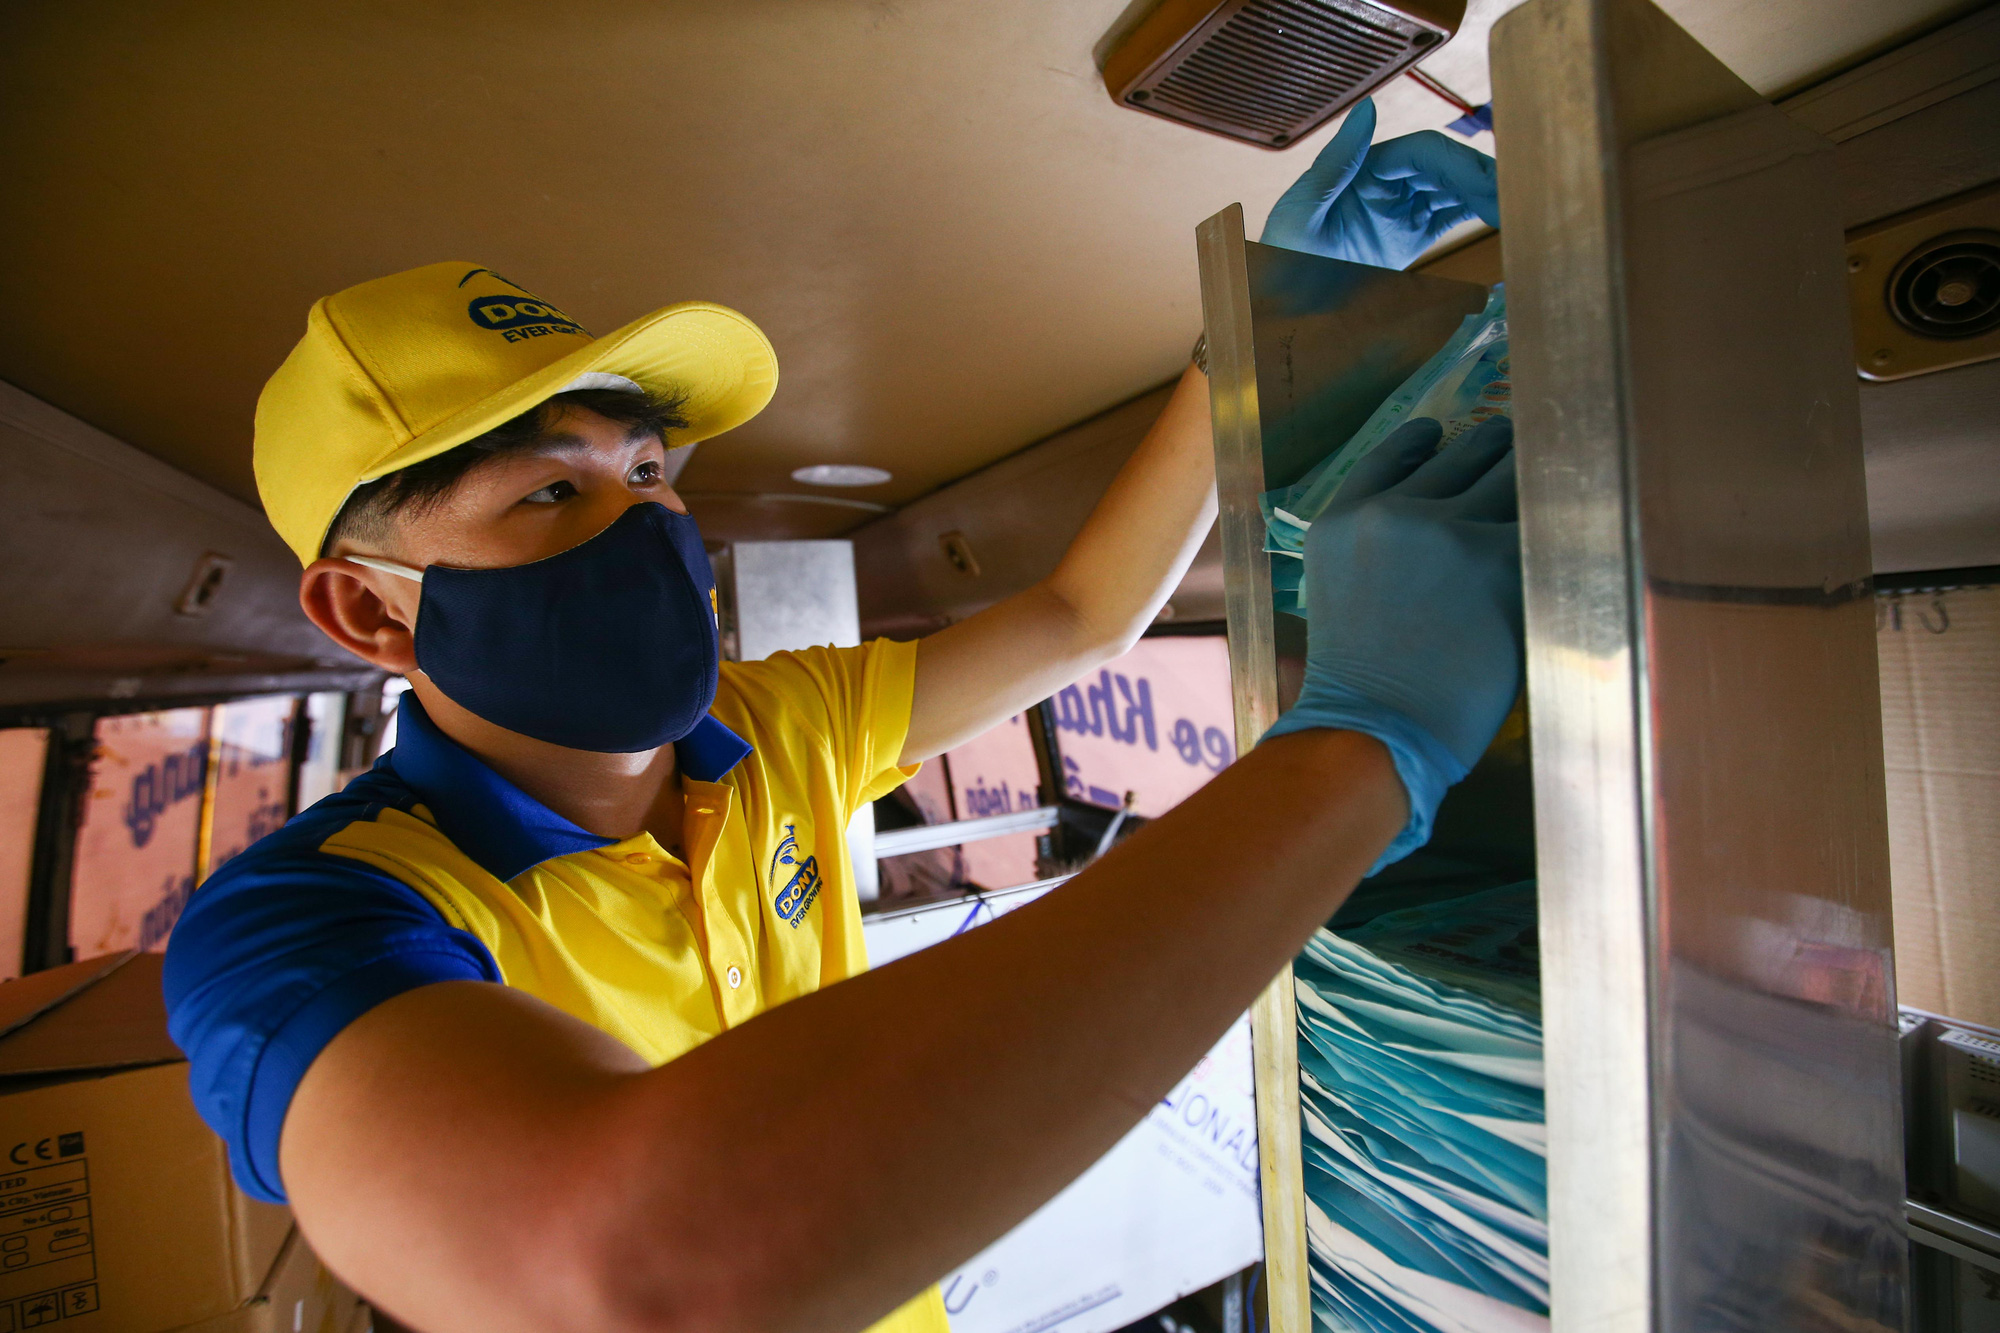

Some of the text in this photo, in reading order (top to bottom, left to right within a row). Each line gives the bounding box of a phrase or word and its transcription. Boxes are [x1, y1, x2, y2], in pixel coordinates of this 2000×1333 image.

[501, 325, 552, 343] EVER
[779, 860, 816, 915] DONY
[790, 907, 807, 929] EVER
